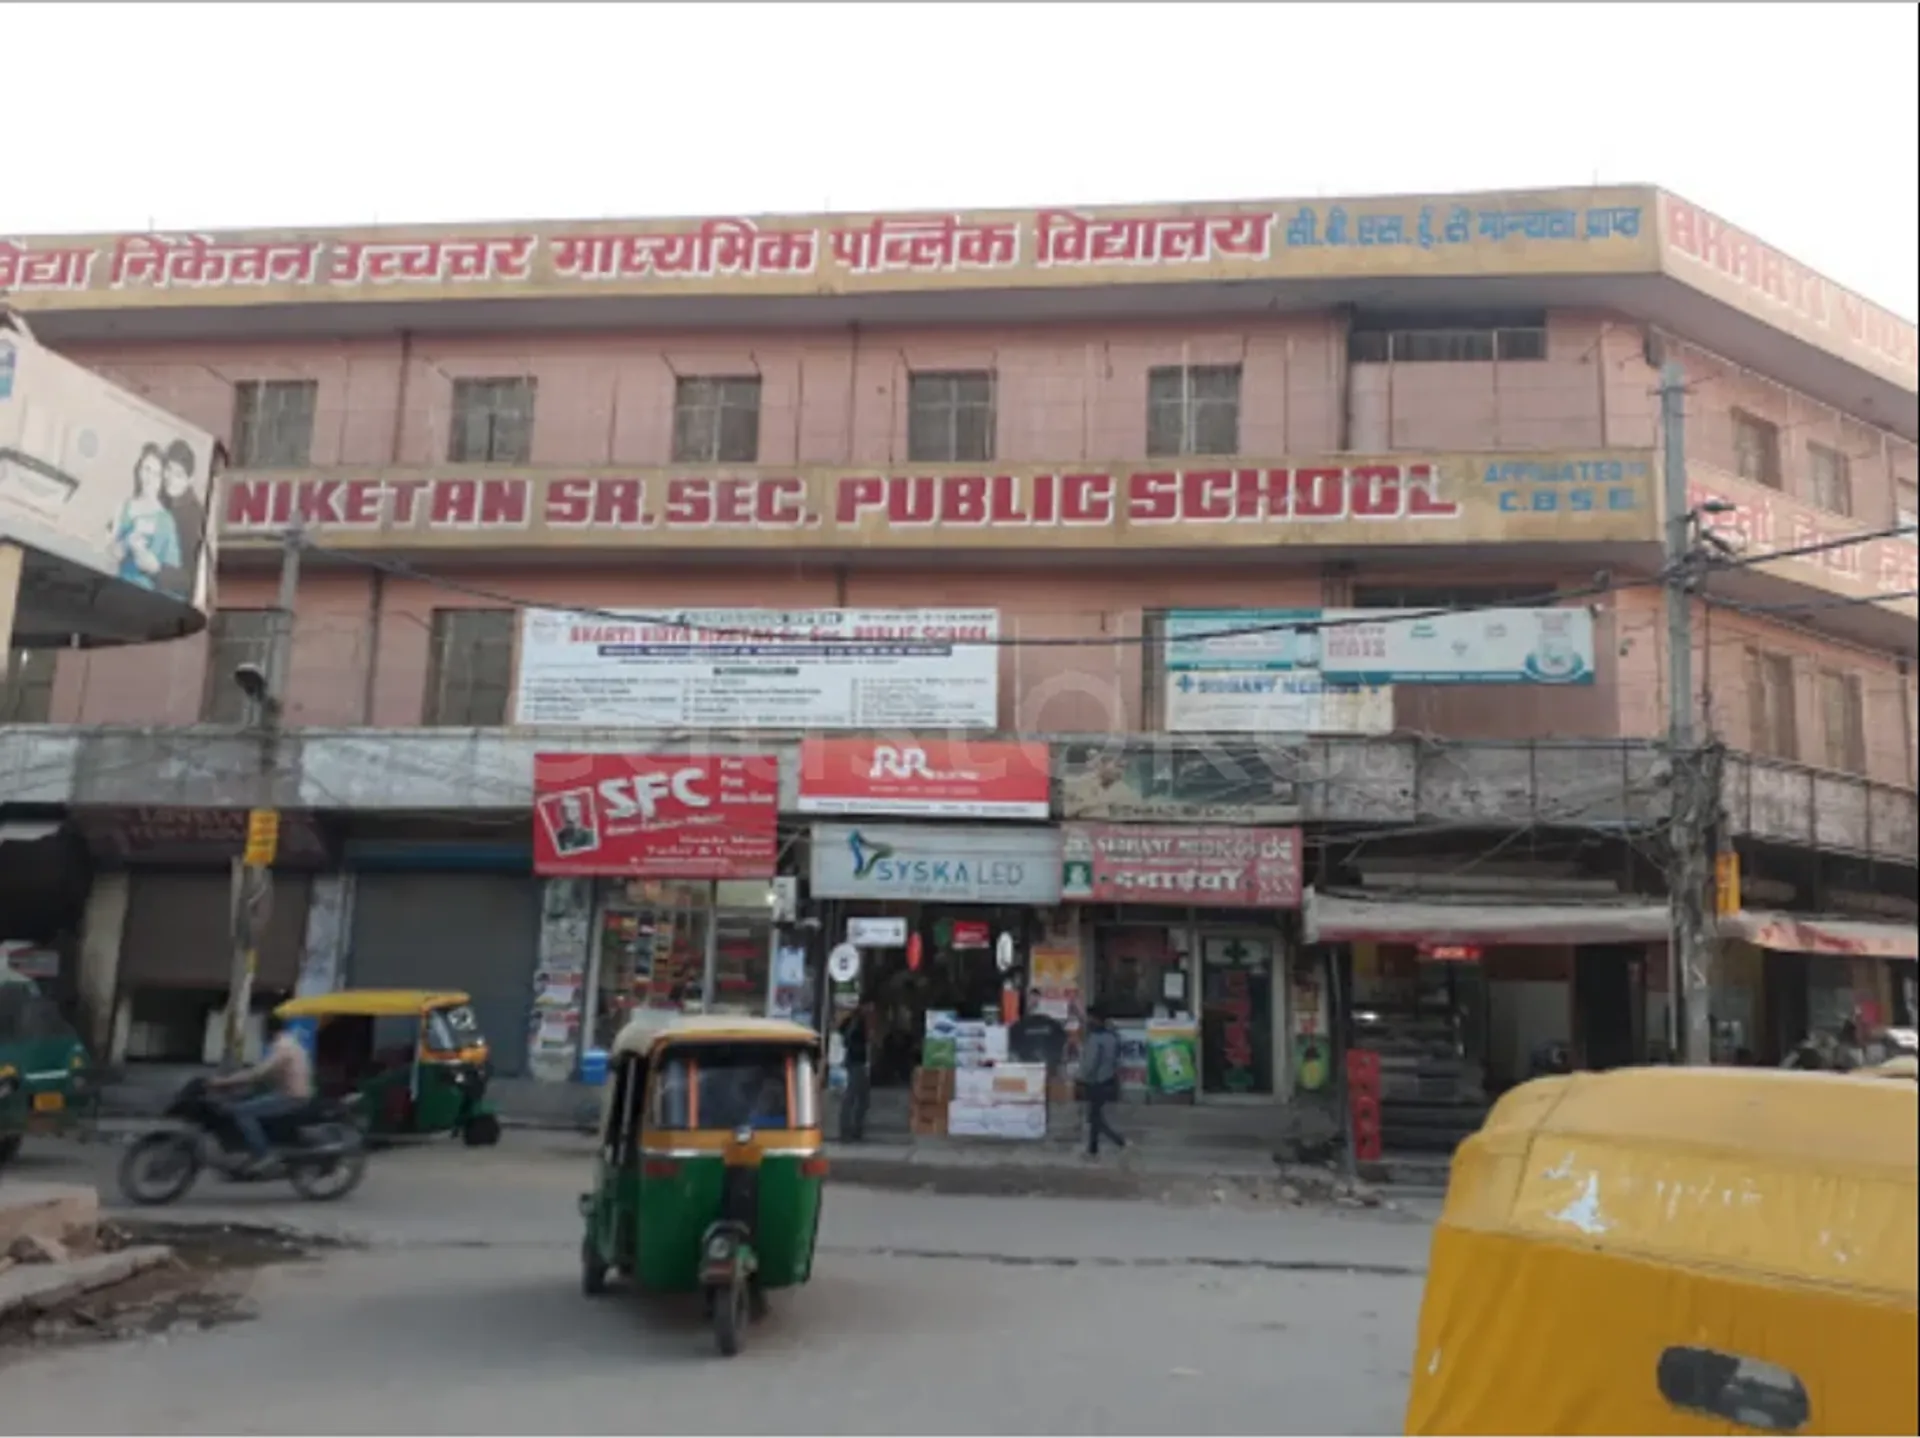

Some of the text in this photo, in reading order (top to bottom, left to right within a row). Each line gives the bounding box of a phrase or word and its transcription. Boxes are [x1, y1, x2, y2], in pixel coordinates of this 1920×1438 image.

[110, 233, 317, 289] निकेतन
[1035, 210, 1278, 268] विद्यालय
[227, 464, 1461, 532] NIKETAN SR. SEC. PUBLIC SCHOOL
[869, 745, 935, 780] RR
[599, 767, 712, 818] SFC
[876, 860, 1024, 886] SYSKA LED
